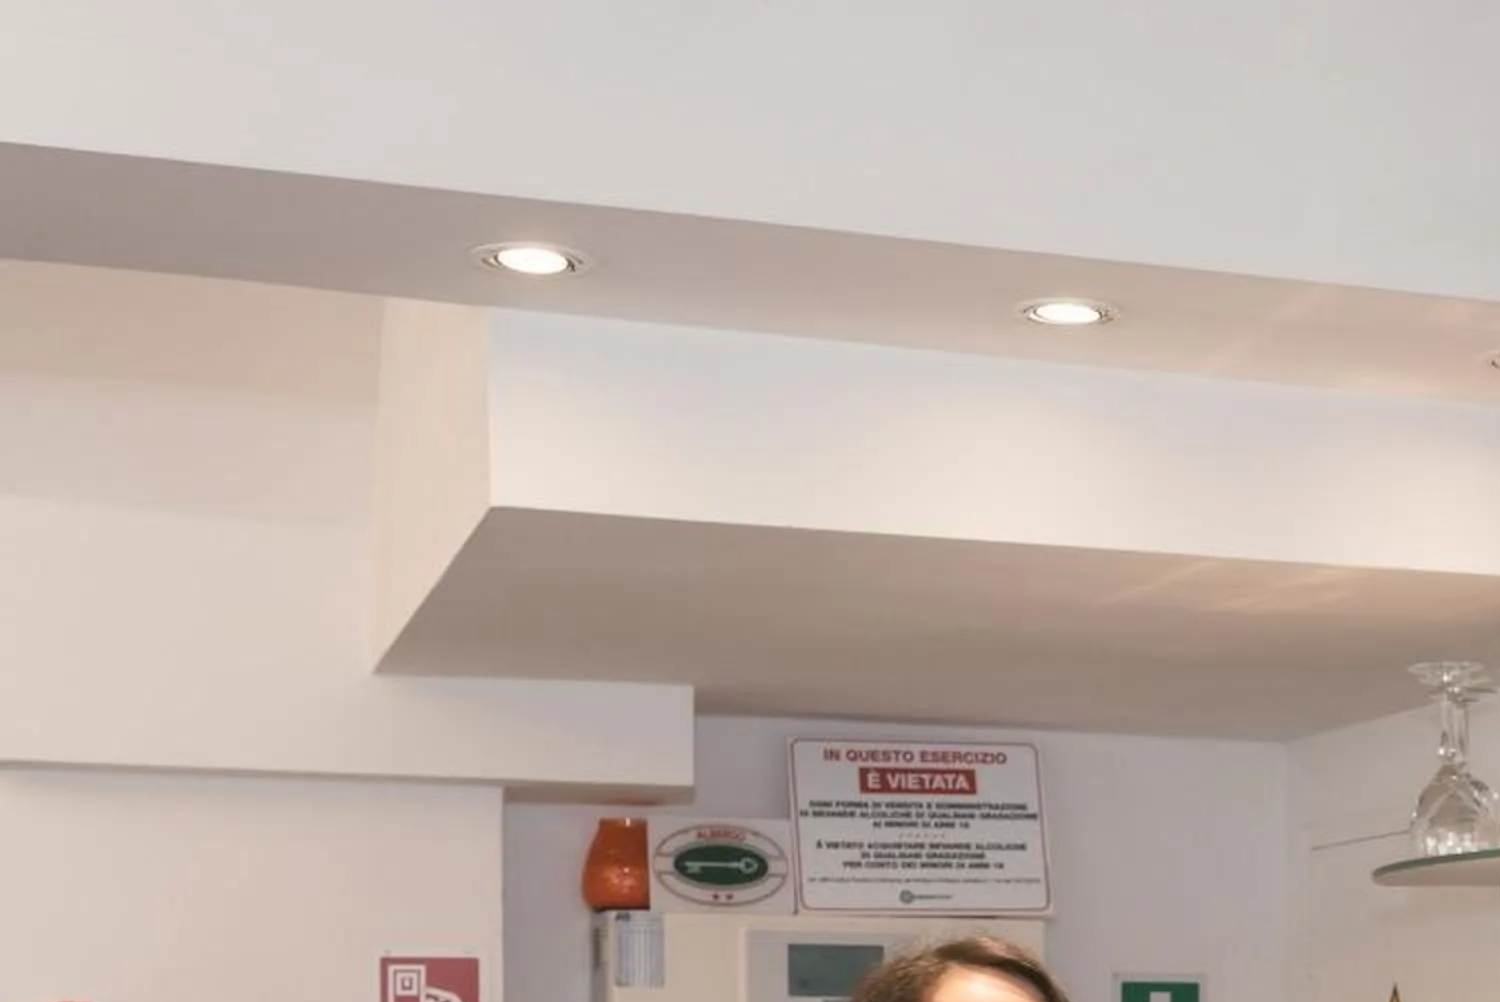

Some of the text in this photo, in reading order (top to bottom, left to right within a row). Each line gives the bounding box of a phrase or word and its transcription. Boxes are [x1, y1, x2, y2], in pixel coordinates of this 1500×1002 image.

[823, 748, 1007, 764] IN QUESTO ESERCIZIO
[867, 772, 970, 791] È VIETATA
